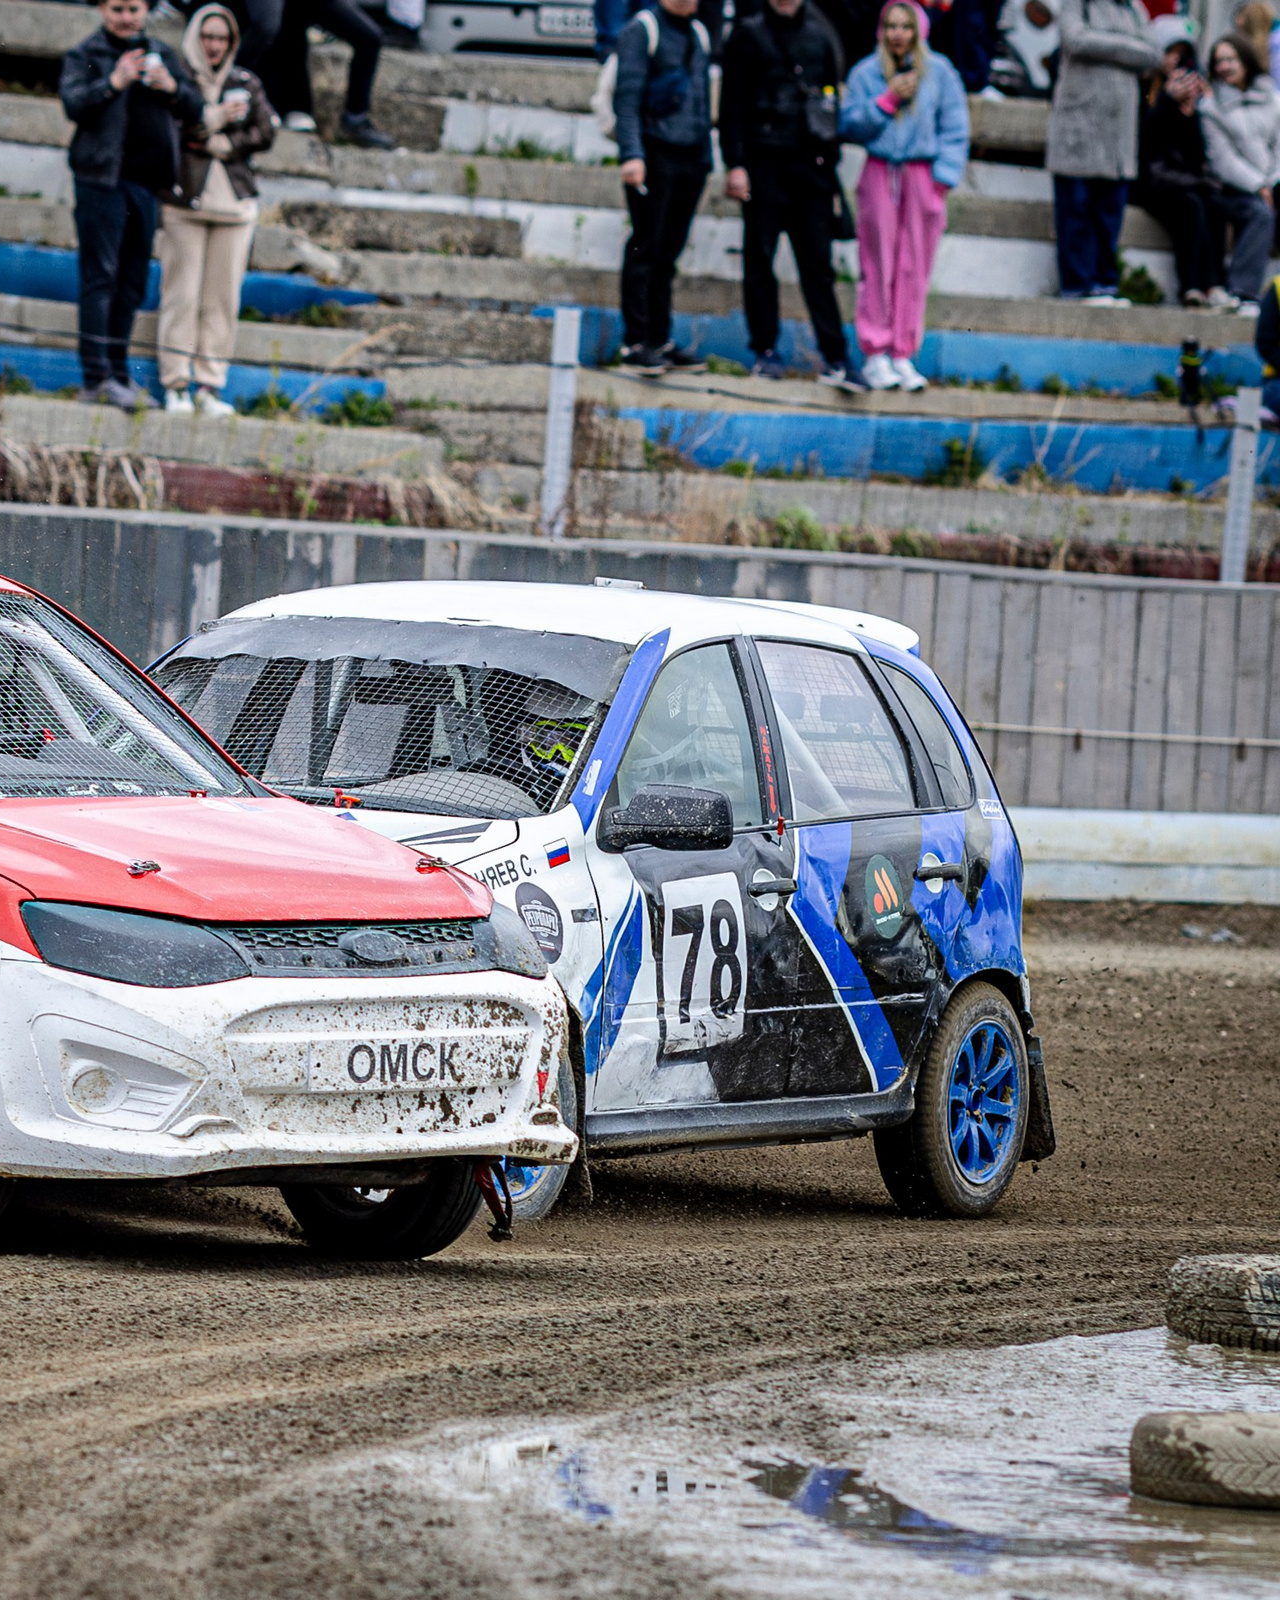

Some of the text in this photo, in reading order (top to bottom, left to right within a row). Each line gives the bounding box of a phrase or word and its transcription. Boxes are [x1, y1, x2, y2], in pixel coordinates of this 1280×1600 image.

[520, 853, 538, 877] С.
[671, 898, 742, 1024] 78
[347, 1042, 461, 1084] ОМСК
